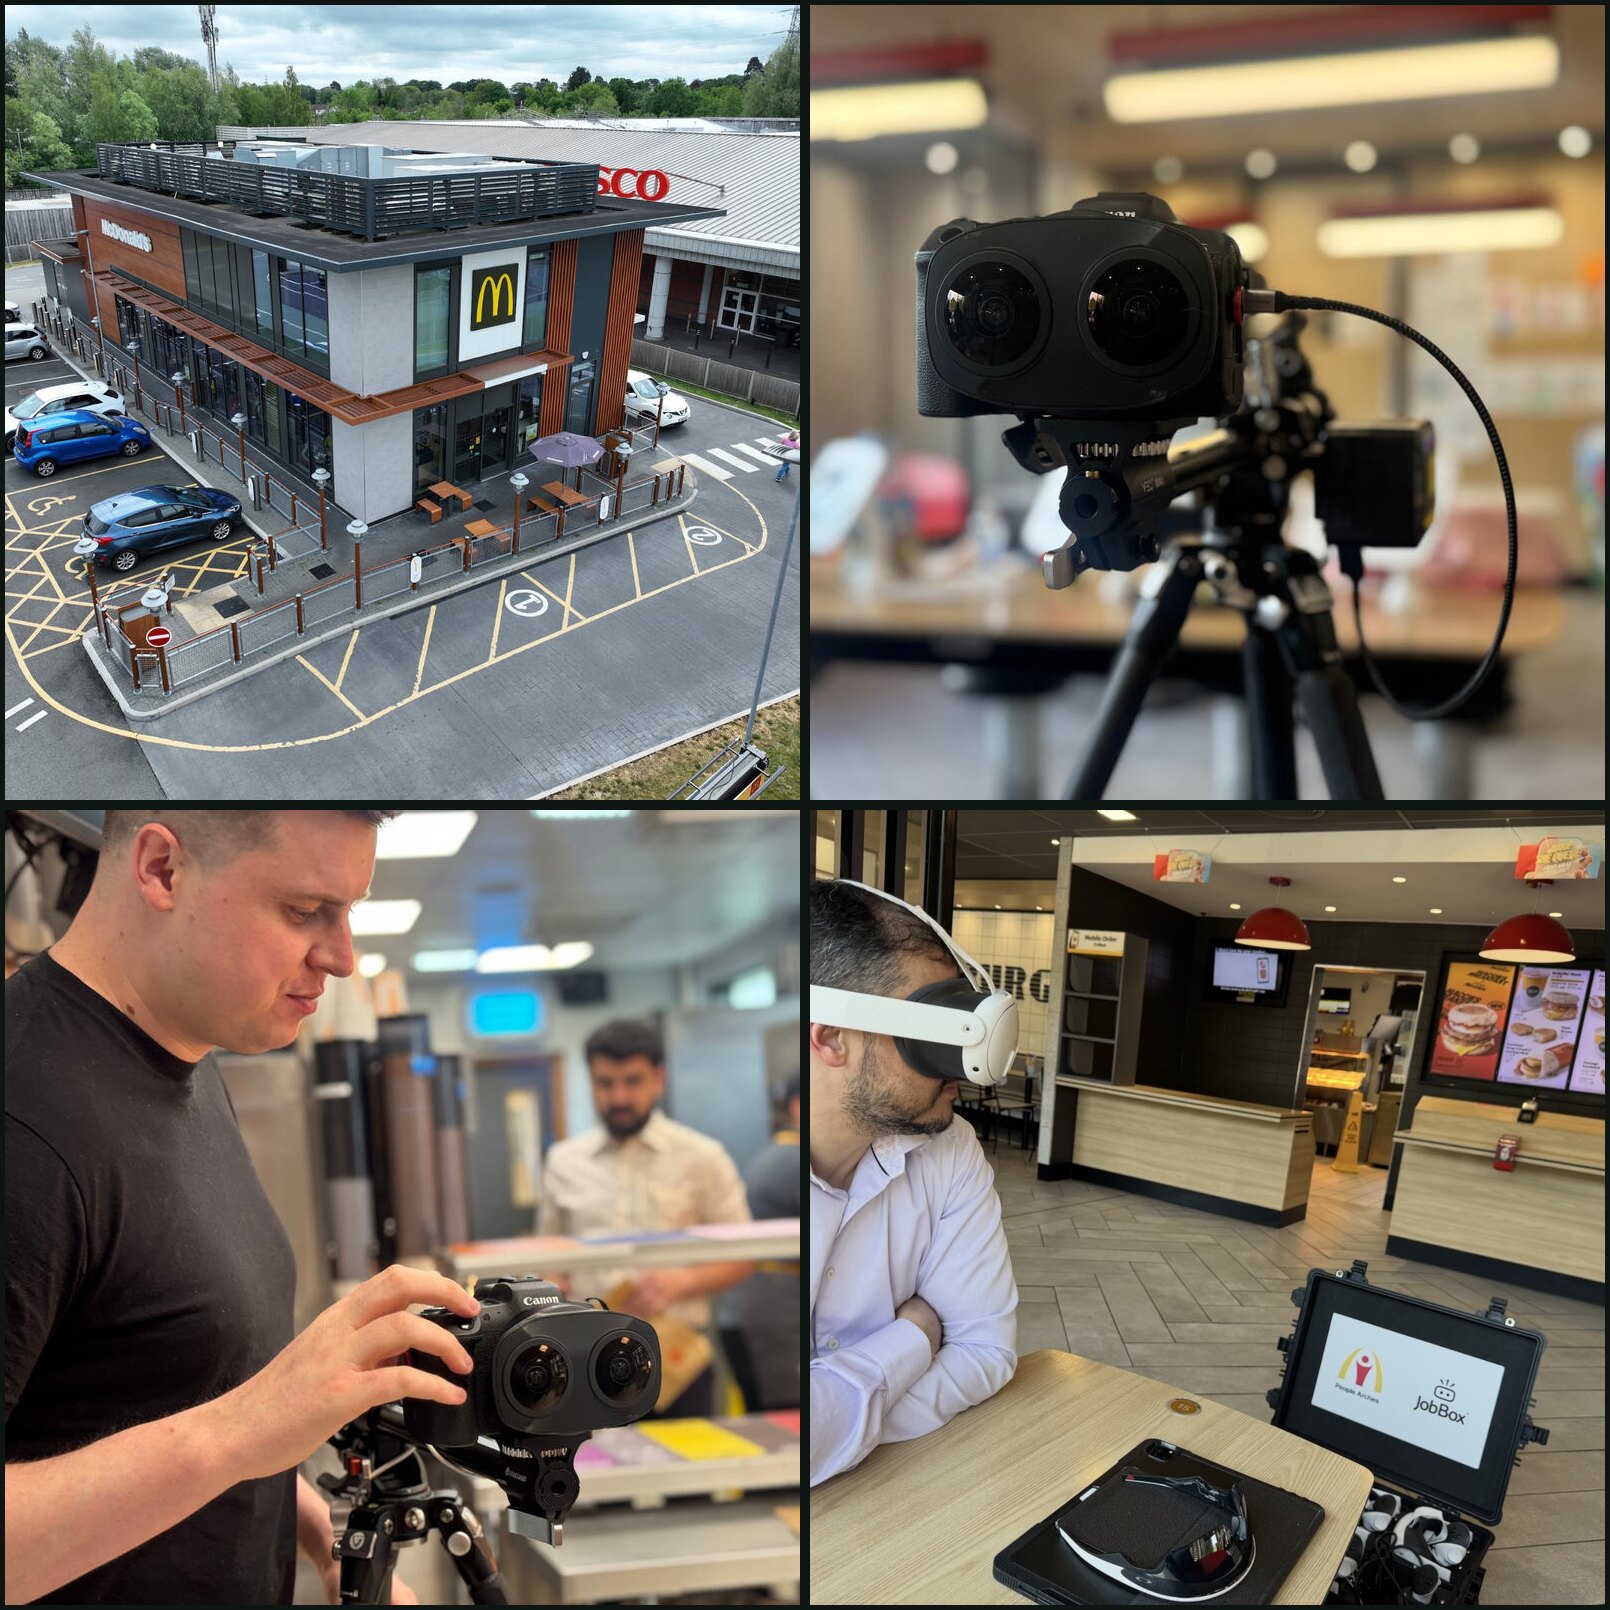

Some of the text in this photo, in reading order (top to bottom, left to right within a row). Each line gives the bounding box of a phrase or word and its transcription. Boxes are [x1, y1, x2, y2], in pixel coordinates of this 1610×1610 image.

[523, 1296, 560, 1306] Canon
[1334, 1382, 1380, 1404] People Arches
[1413, 1395, 1467, 1425] JobBox
